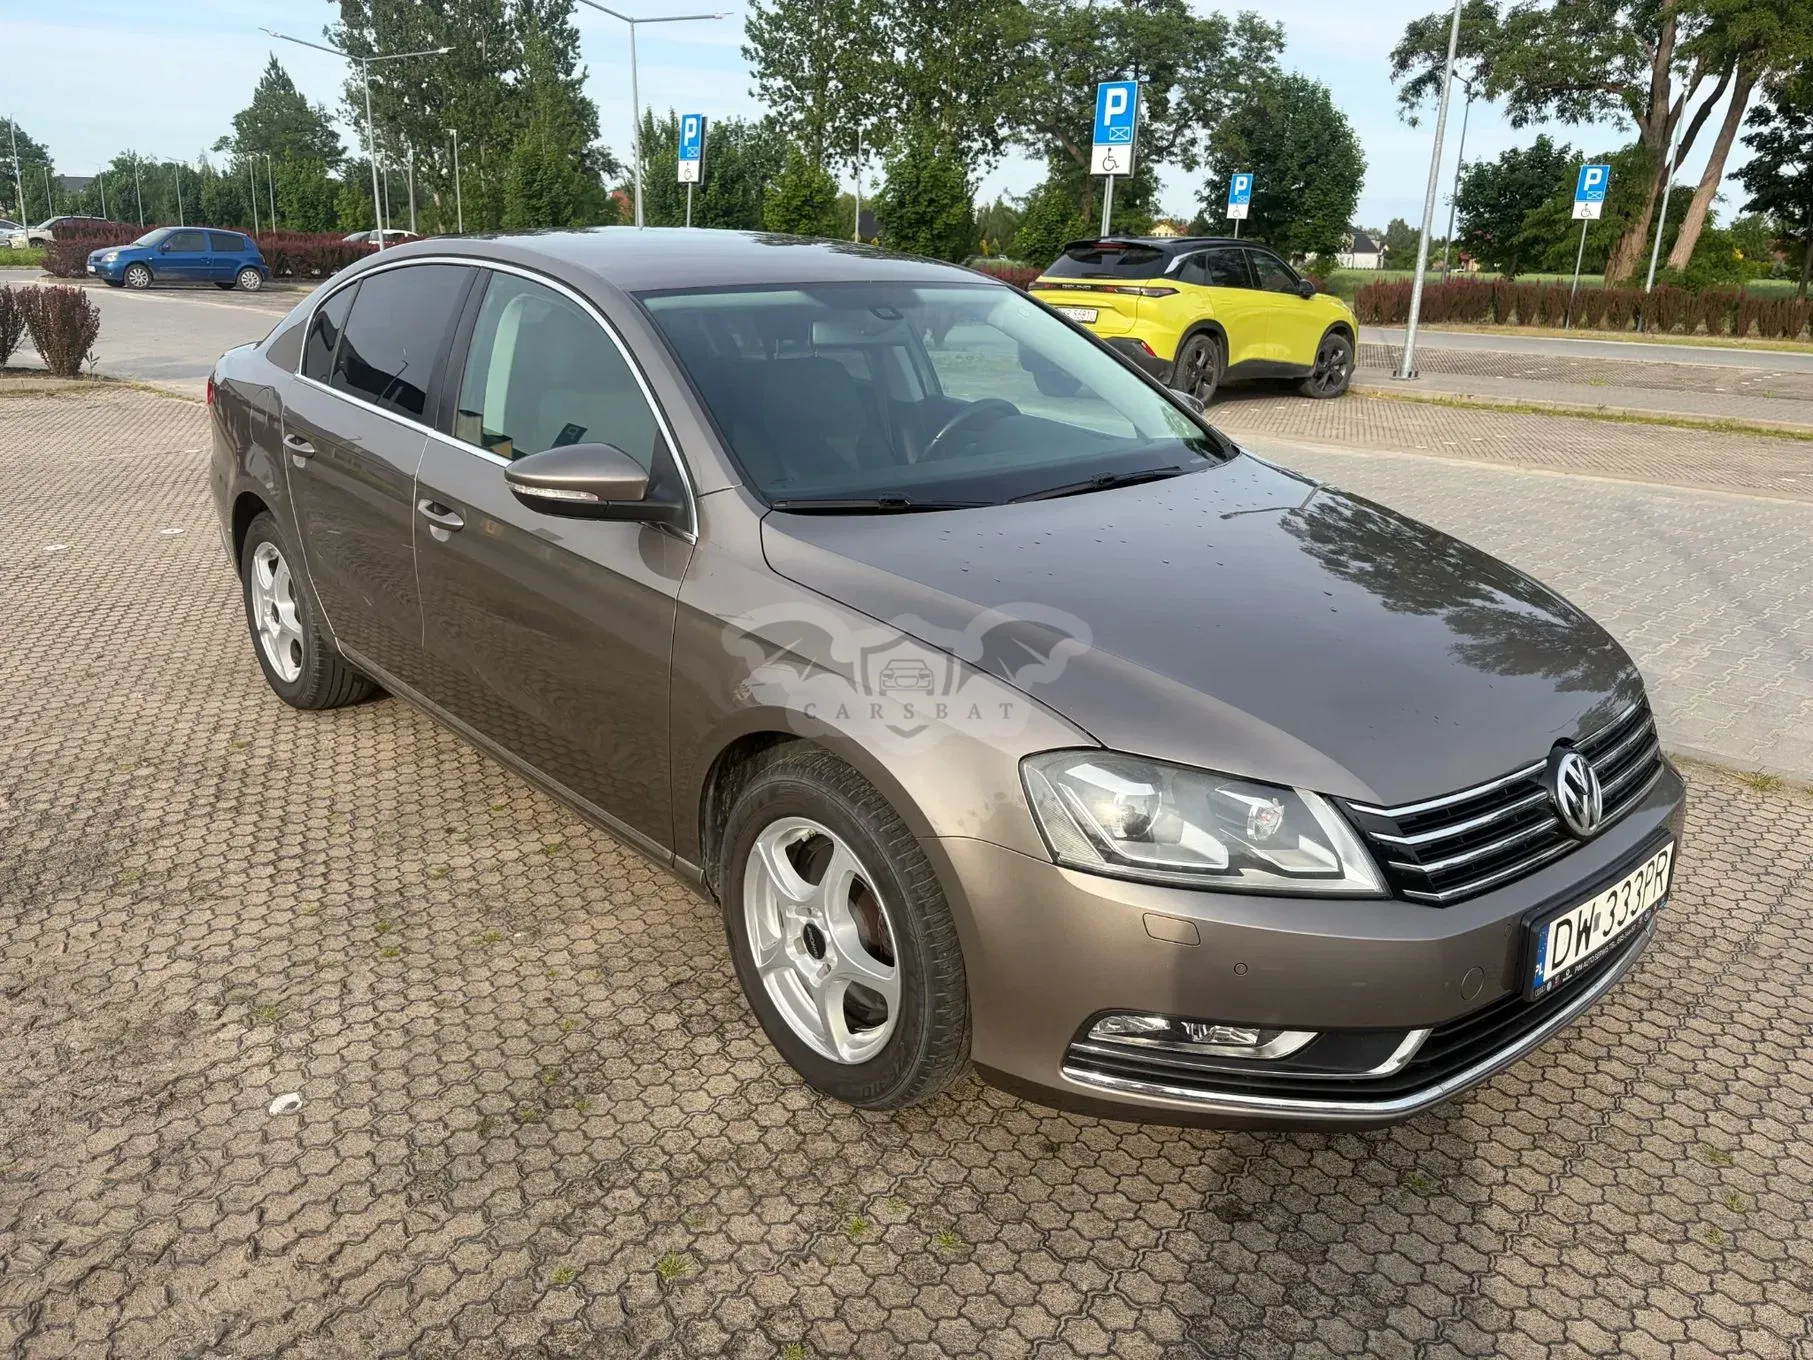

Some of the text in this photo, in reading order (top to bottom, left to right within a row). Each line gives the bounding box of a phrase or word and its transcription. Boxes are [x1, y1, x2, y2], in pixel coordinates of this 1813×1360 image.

[1104, 87, 1127, 126] P
[684, 118, 698, 146] P
[1235, 177, 1248, 195] P
[1584, 168, 1603, 191] P
[1551, 850, 1668, 971] DW 333PR
[1535, 962, 1544, 976] PL
